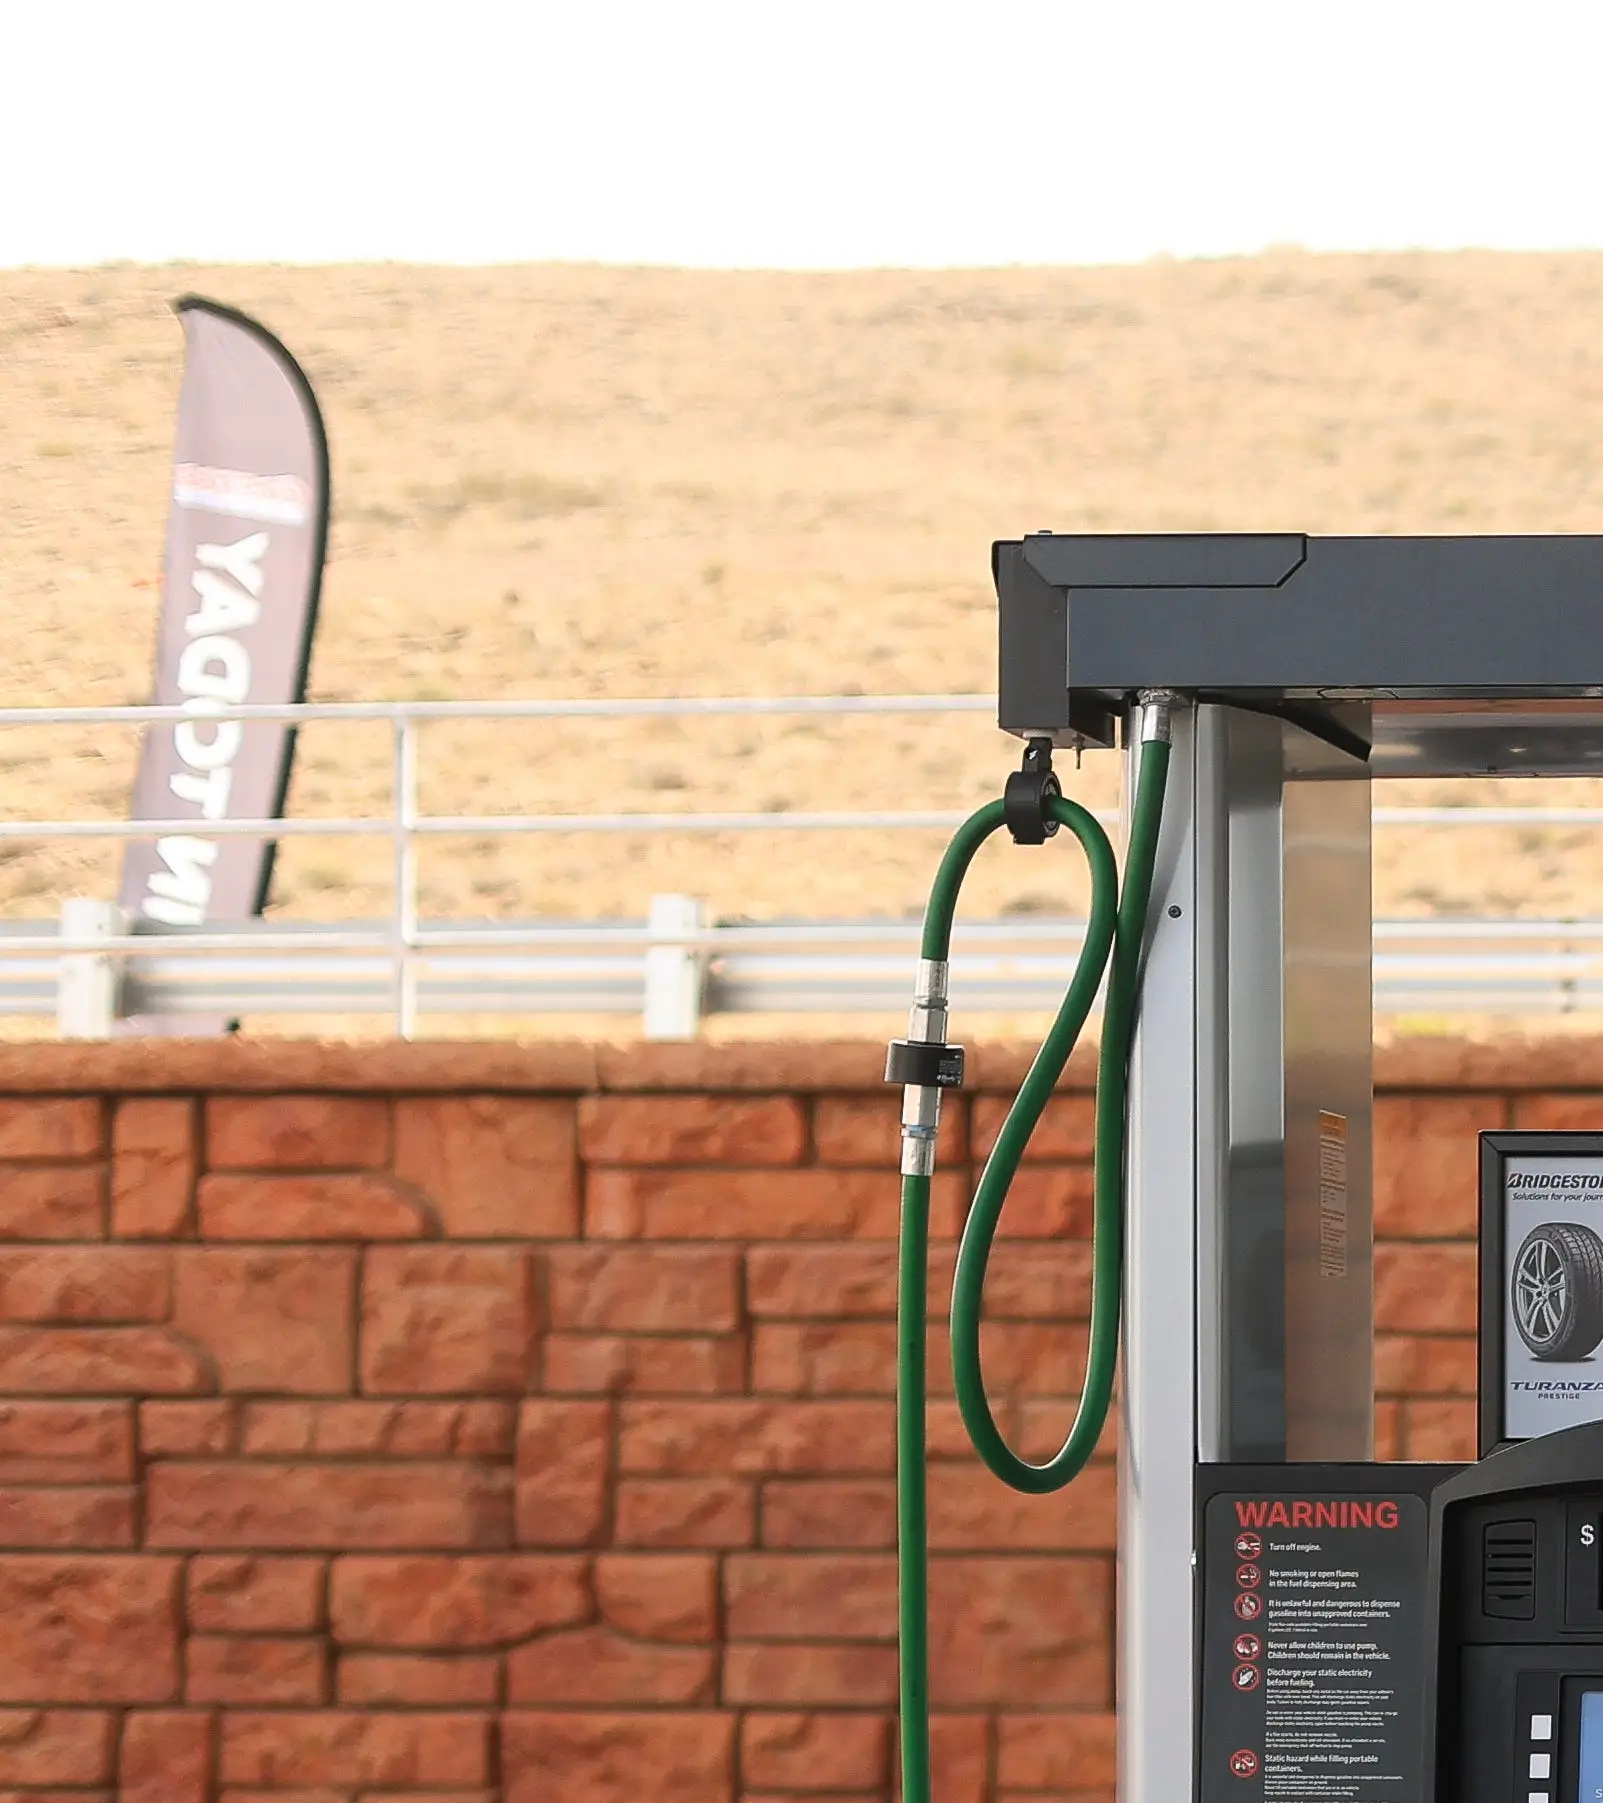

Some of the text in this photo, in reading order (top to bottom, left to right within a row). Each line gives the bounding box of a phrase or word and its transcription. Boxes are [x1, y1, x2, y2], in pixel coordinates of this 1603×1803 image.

[1512, 1193, 1548, 1201] Solutions
[1550, 1193, 1562, 1201] for
[1234, 1501, 1399, 1528] WARNING
[1580, 1524, 1594, 1547] $
[1269, 1543, 1285, 1551] Turn
[1285, 1543, 1296, 1551] off
